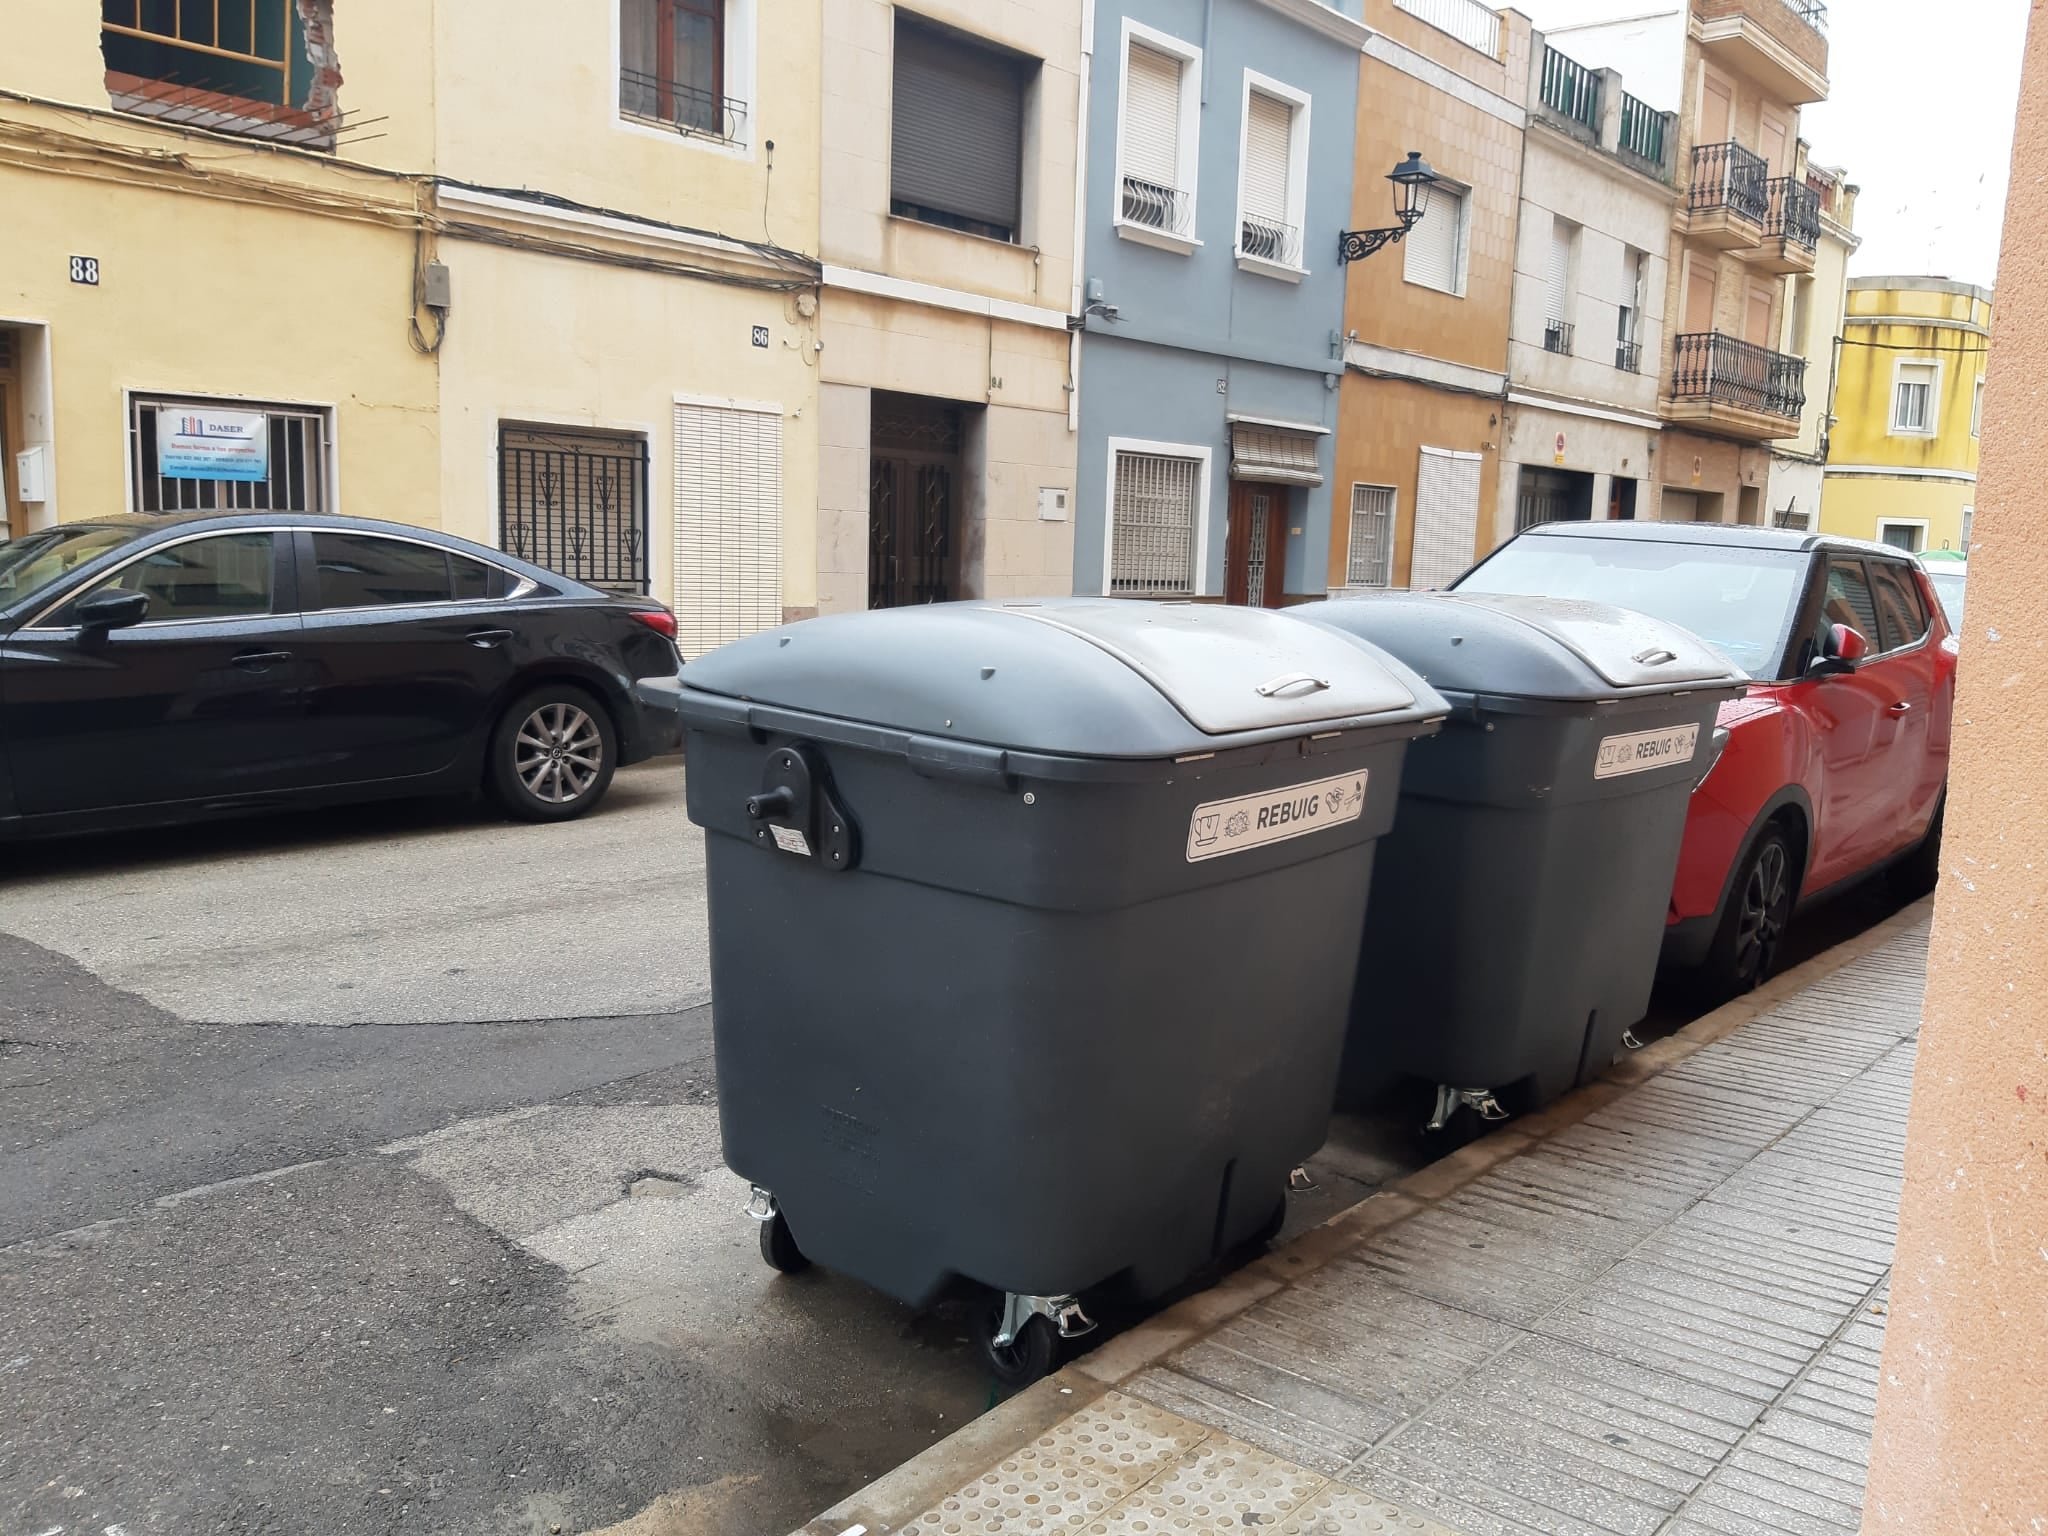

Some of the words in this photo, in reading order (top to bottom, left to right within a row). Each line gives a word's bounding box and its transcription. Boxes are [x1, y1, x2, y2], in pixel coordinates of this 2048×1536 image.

[71, 257, 98, 283] 88
[754, 328, 767, 346] 86
[209, 424, 244, 433] DASER
[1636, 738, 1671, 760] REBUIG
[1257, 795, 1319, 830] REBUIG
